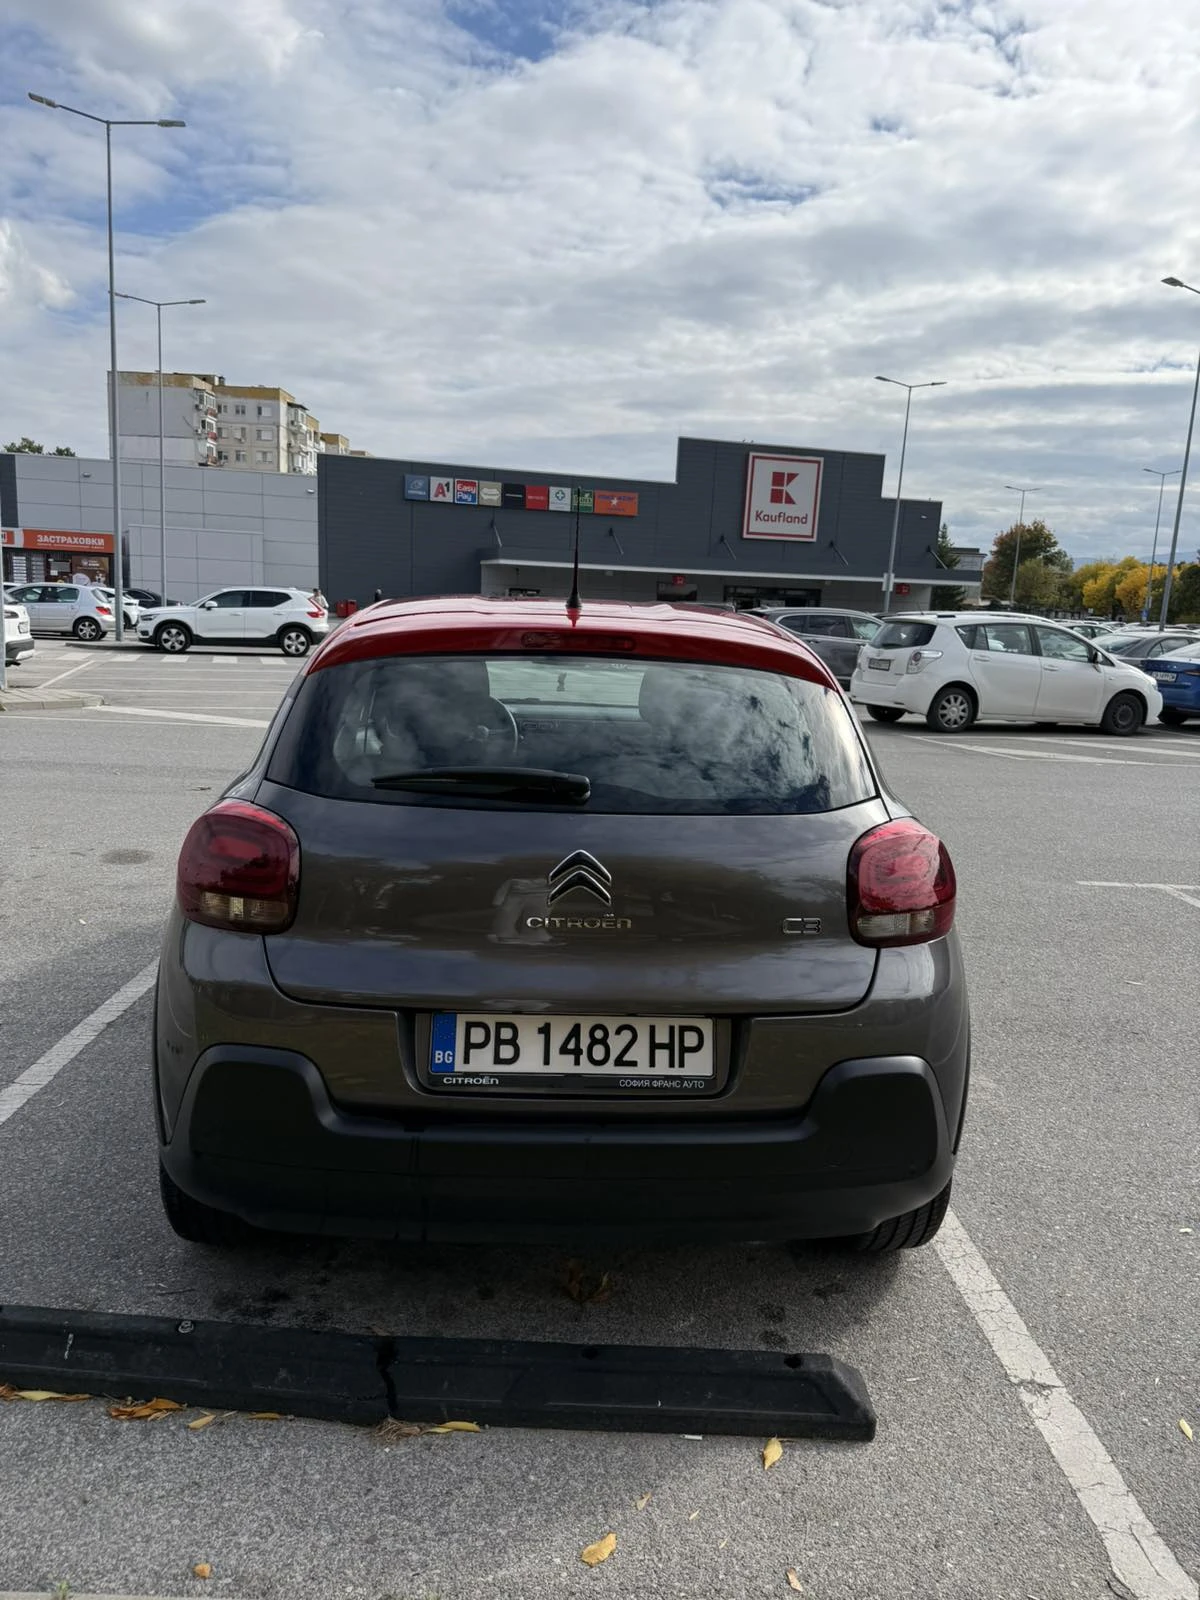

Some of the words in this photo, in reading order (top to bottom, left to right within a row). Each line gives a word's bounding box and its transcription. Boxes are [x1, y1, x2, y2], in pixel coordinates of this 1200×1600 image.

[434, 481, 450, 498] A1
[457, 483, 476, 493] Easy
[457, 492, 472, 502] Pay
[755, 510, 808, 525] Kaufland
[37, 534, 104, 545] ЗАСТРАХОВКИ
[782, 917, 824, 935] C3
[463, 1021, 520, 1066] PB
[537, 1022, 639, 1067] 1482
[649, 1024, 705, 1069] HP
[434, 1050, 453, 1064] BG
[619, 1078, 650, 1088] СОФИЯ
[651, 1079, 681, 1089] ФРАНС
[682, 1080, 705, 1089] АУТО
